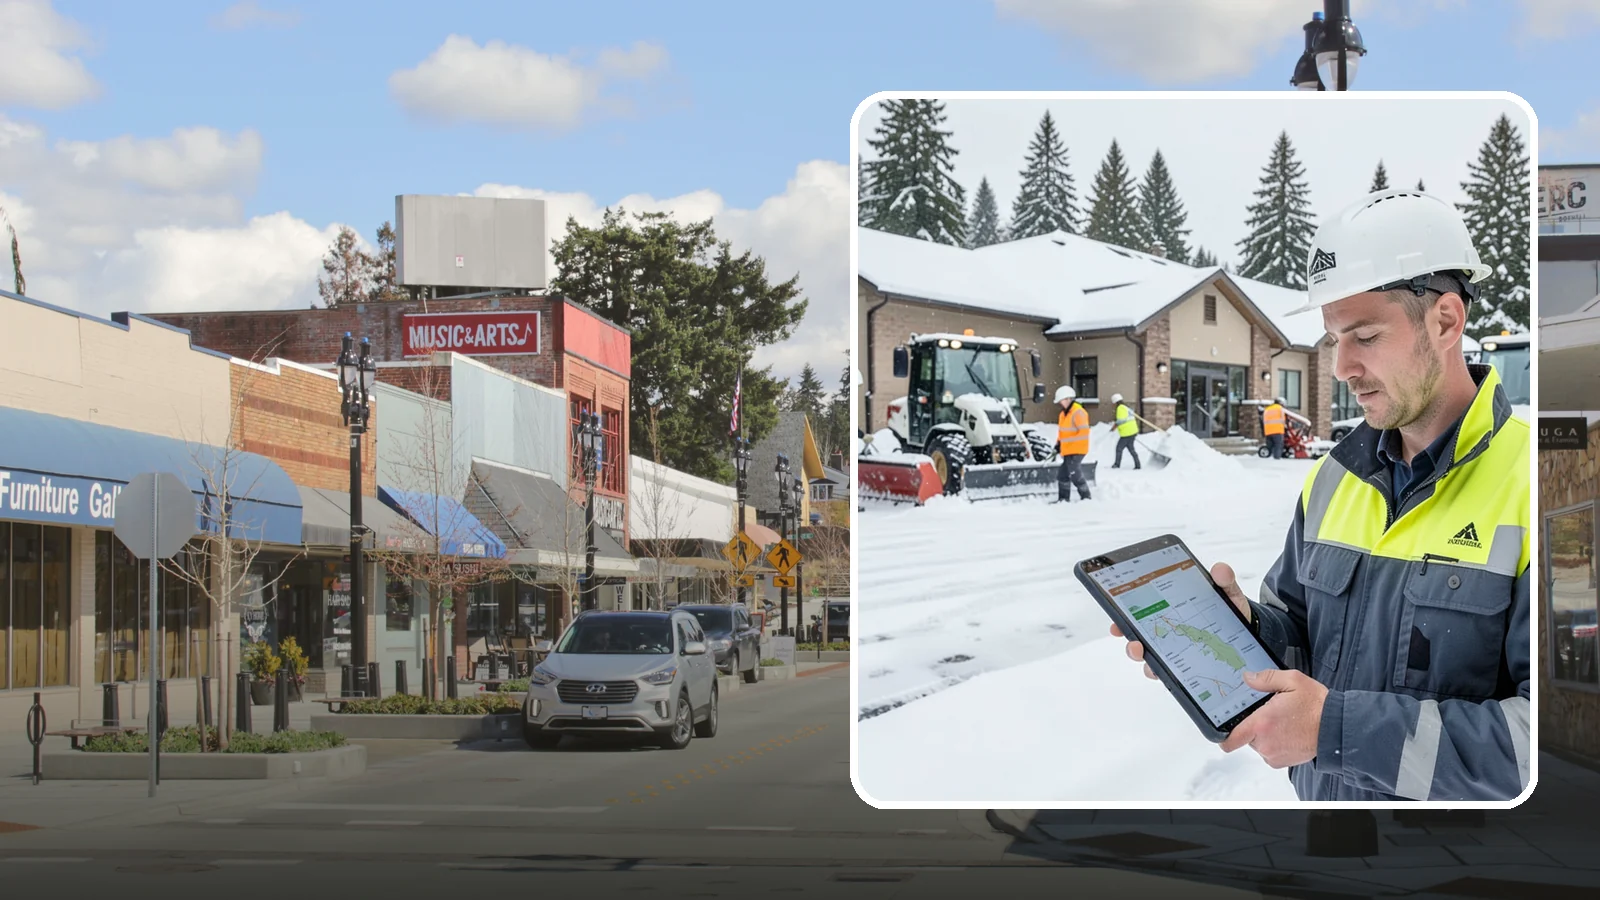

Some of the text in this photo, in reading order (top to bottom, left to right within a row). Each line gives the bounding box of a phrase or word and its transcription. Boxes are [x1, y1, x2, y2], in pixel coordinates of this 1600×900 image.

[409, 322, 519, 349] MUSIC&ARTS
[0, 471, 122, 519] Furniture Gal
